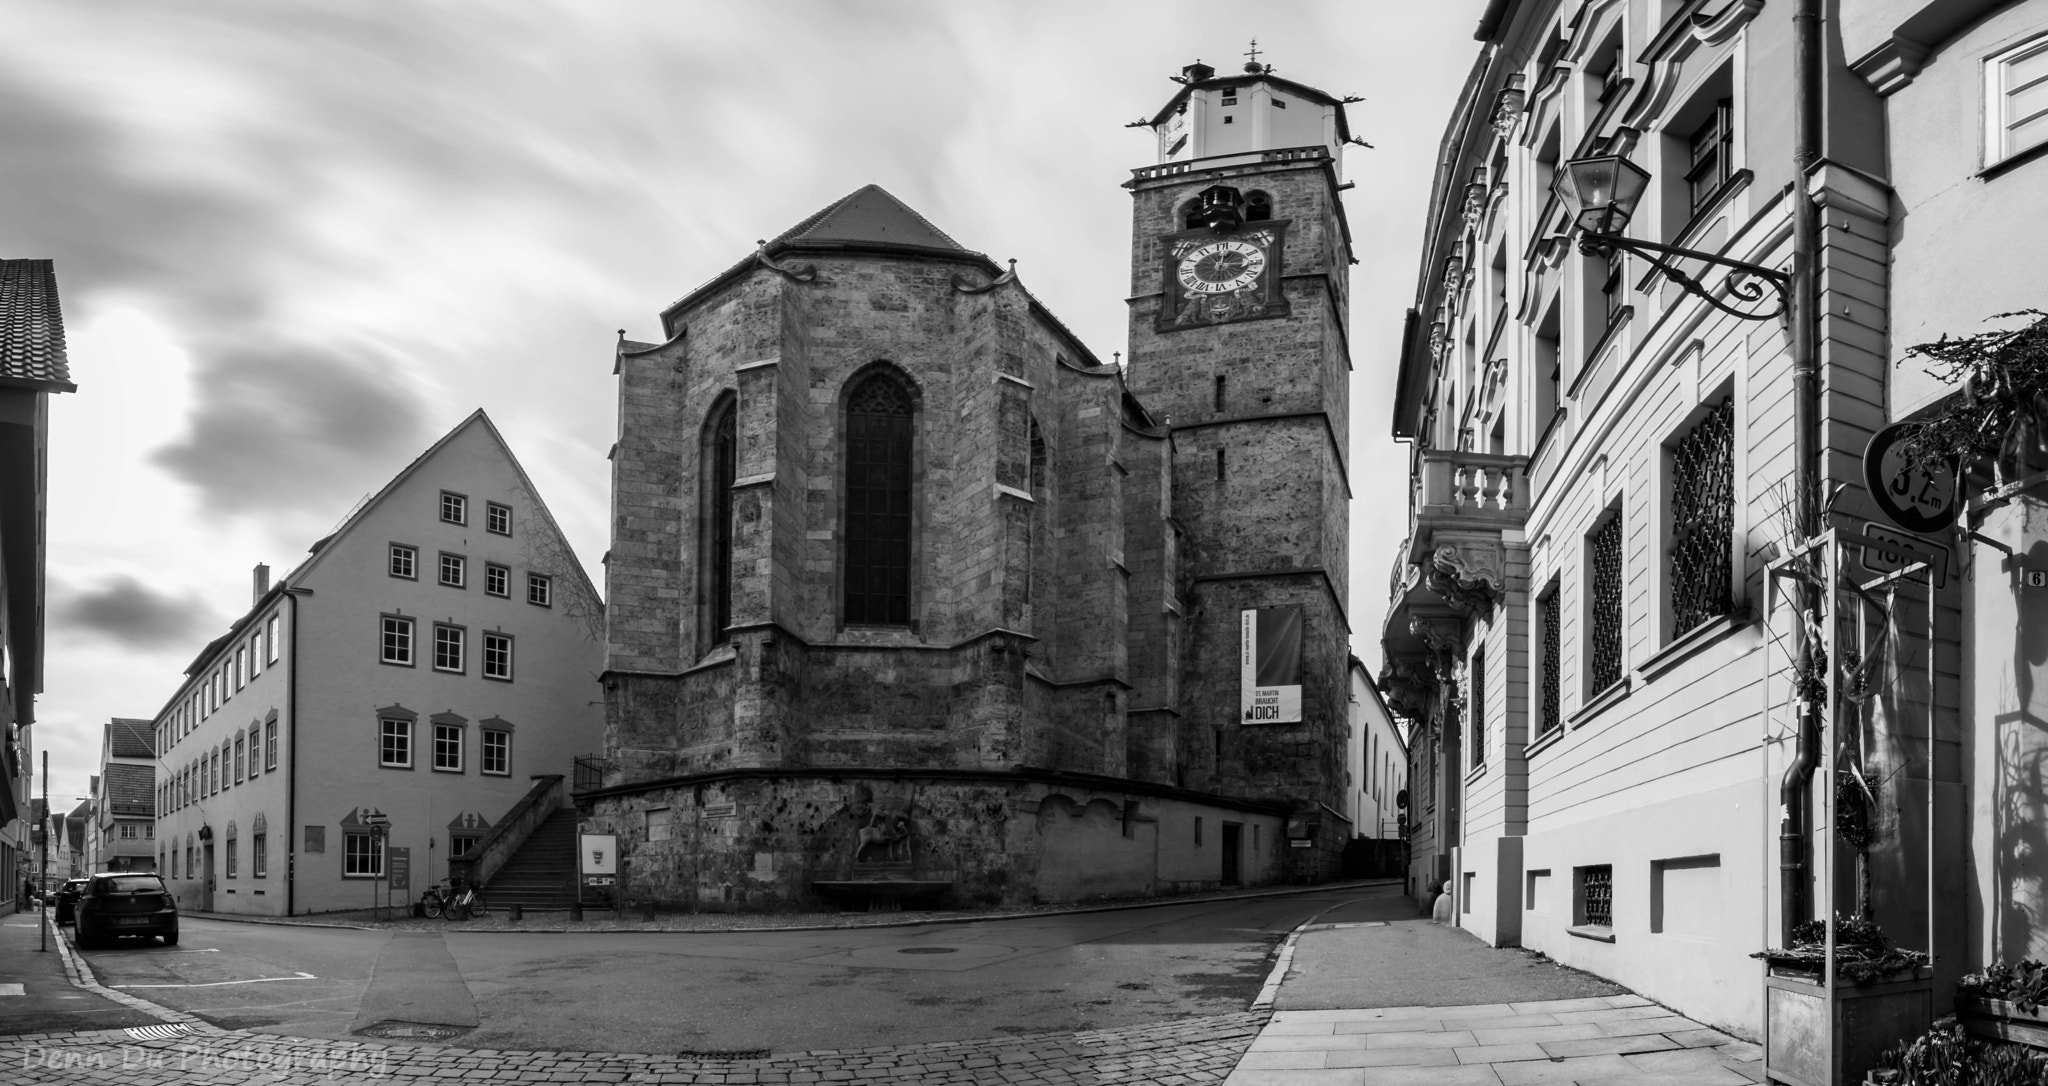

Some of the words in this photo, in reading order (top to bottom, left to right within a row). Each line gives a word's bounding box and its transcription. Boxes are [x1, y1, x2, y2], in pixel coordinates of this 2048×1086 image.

[2032, 572, 2041, 585] 6
[1255, 697, 1279, 705] BRAUCHT
[1255, 705, 1279, 720] DICH
